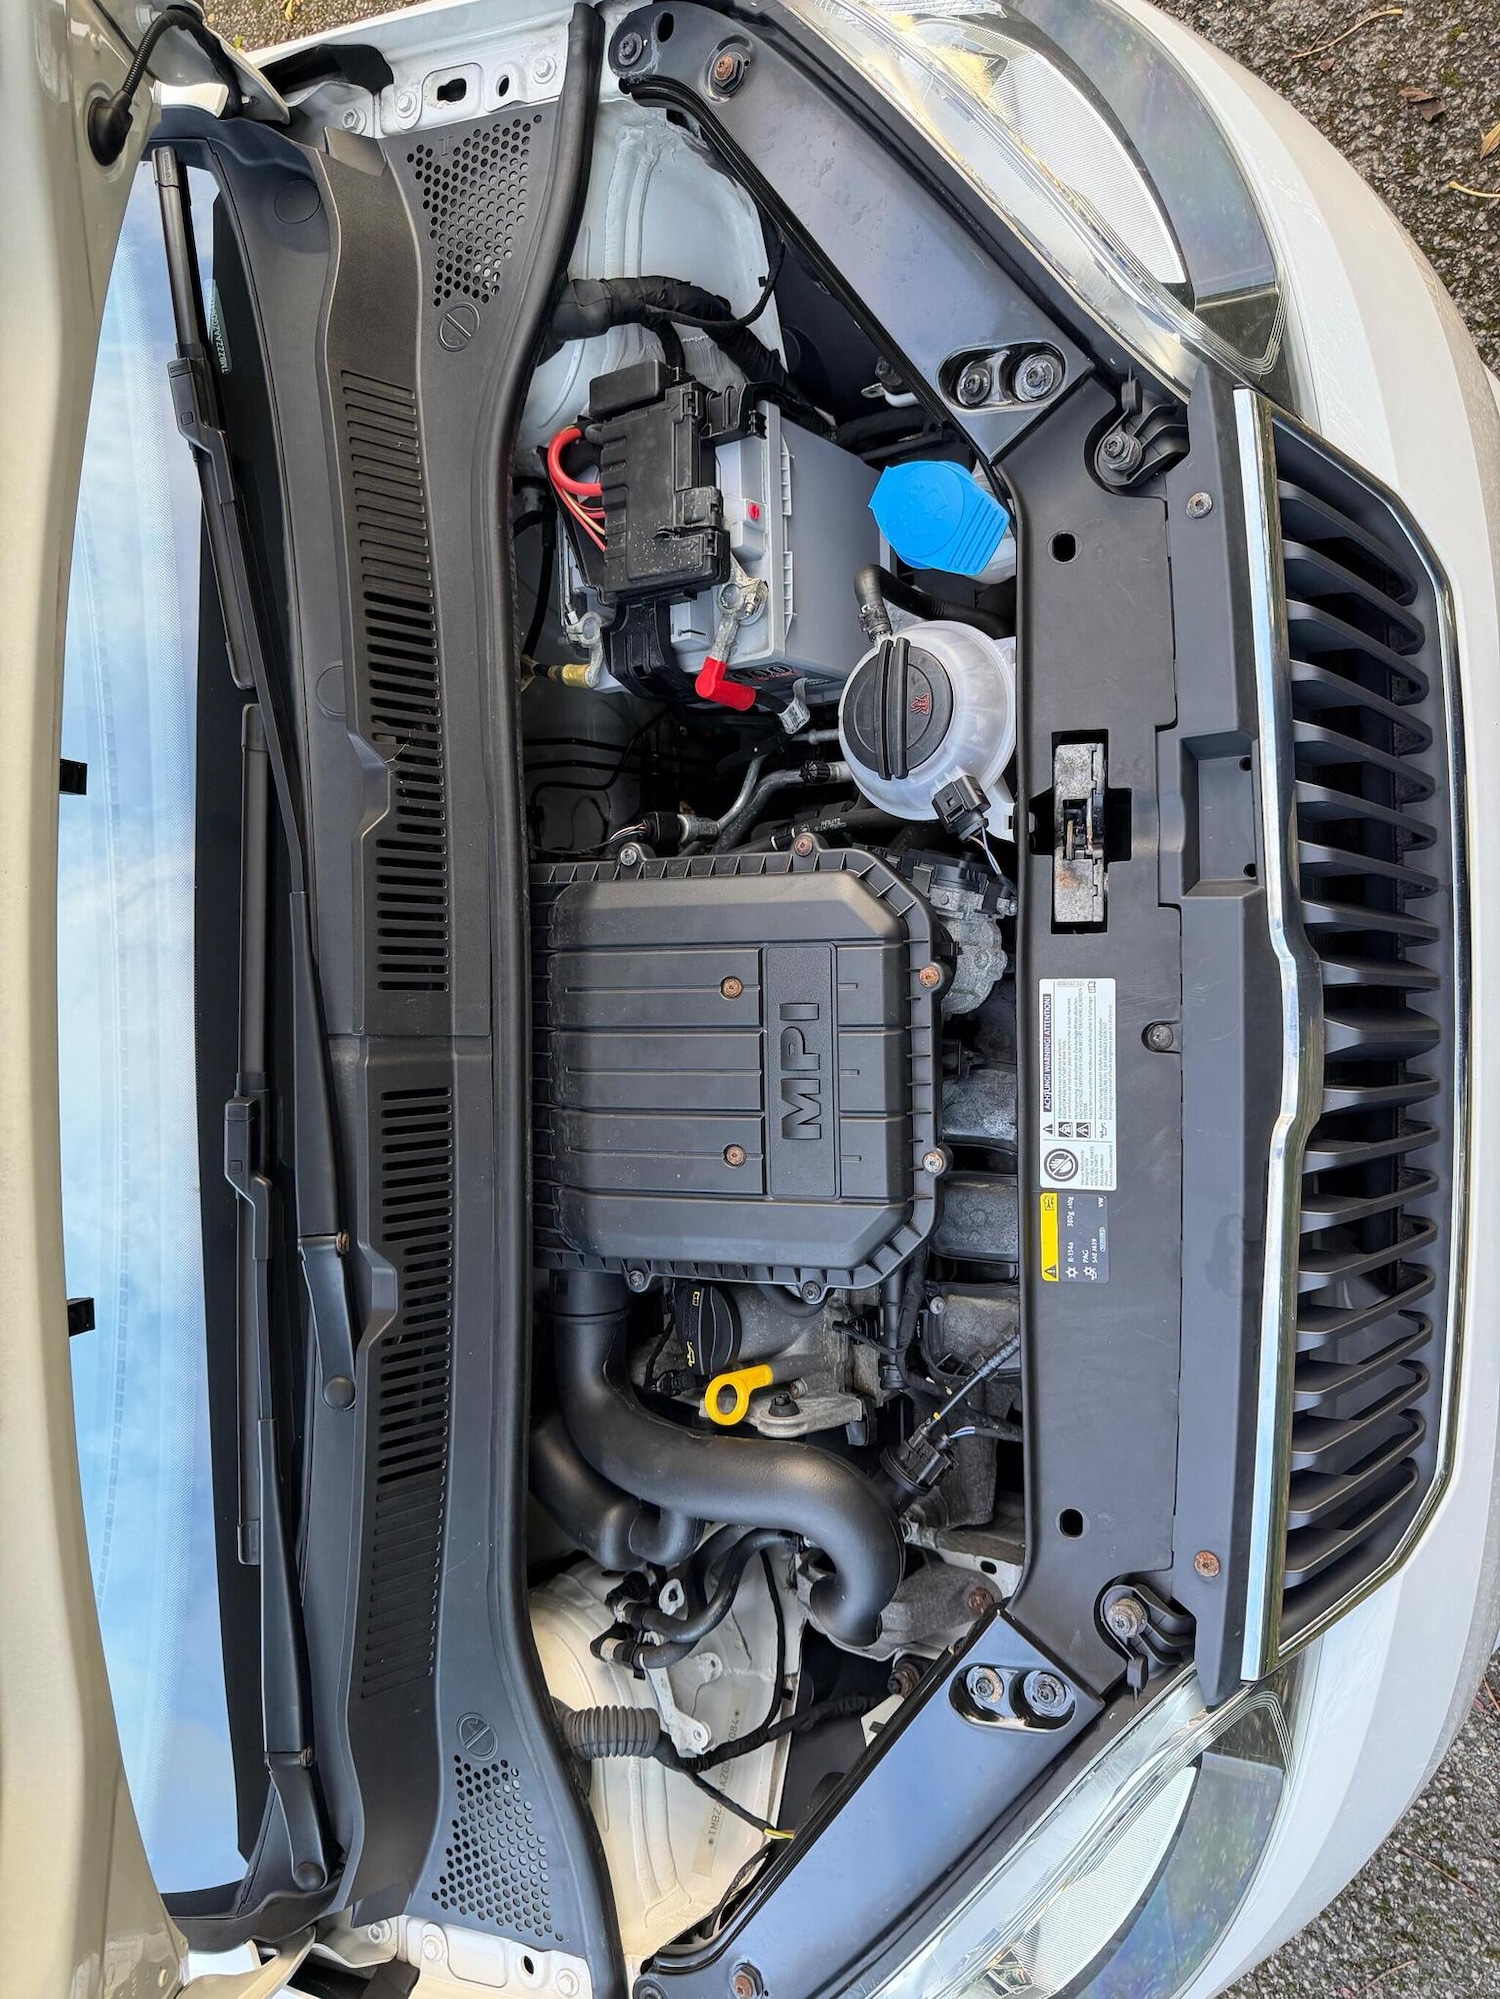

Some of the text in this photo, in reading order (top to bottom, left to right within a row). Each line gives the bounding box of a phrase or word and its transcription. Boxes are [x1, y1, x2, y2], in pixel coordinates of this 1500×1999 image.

[779, 1003, 821, 1140] MPI
[1098, 1196, 1104, 1207] VW
[1067, 1211, 1075, 1227] 380g
